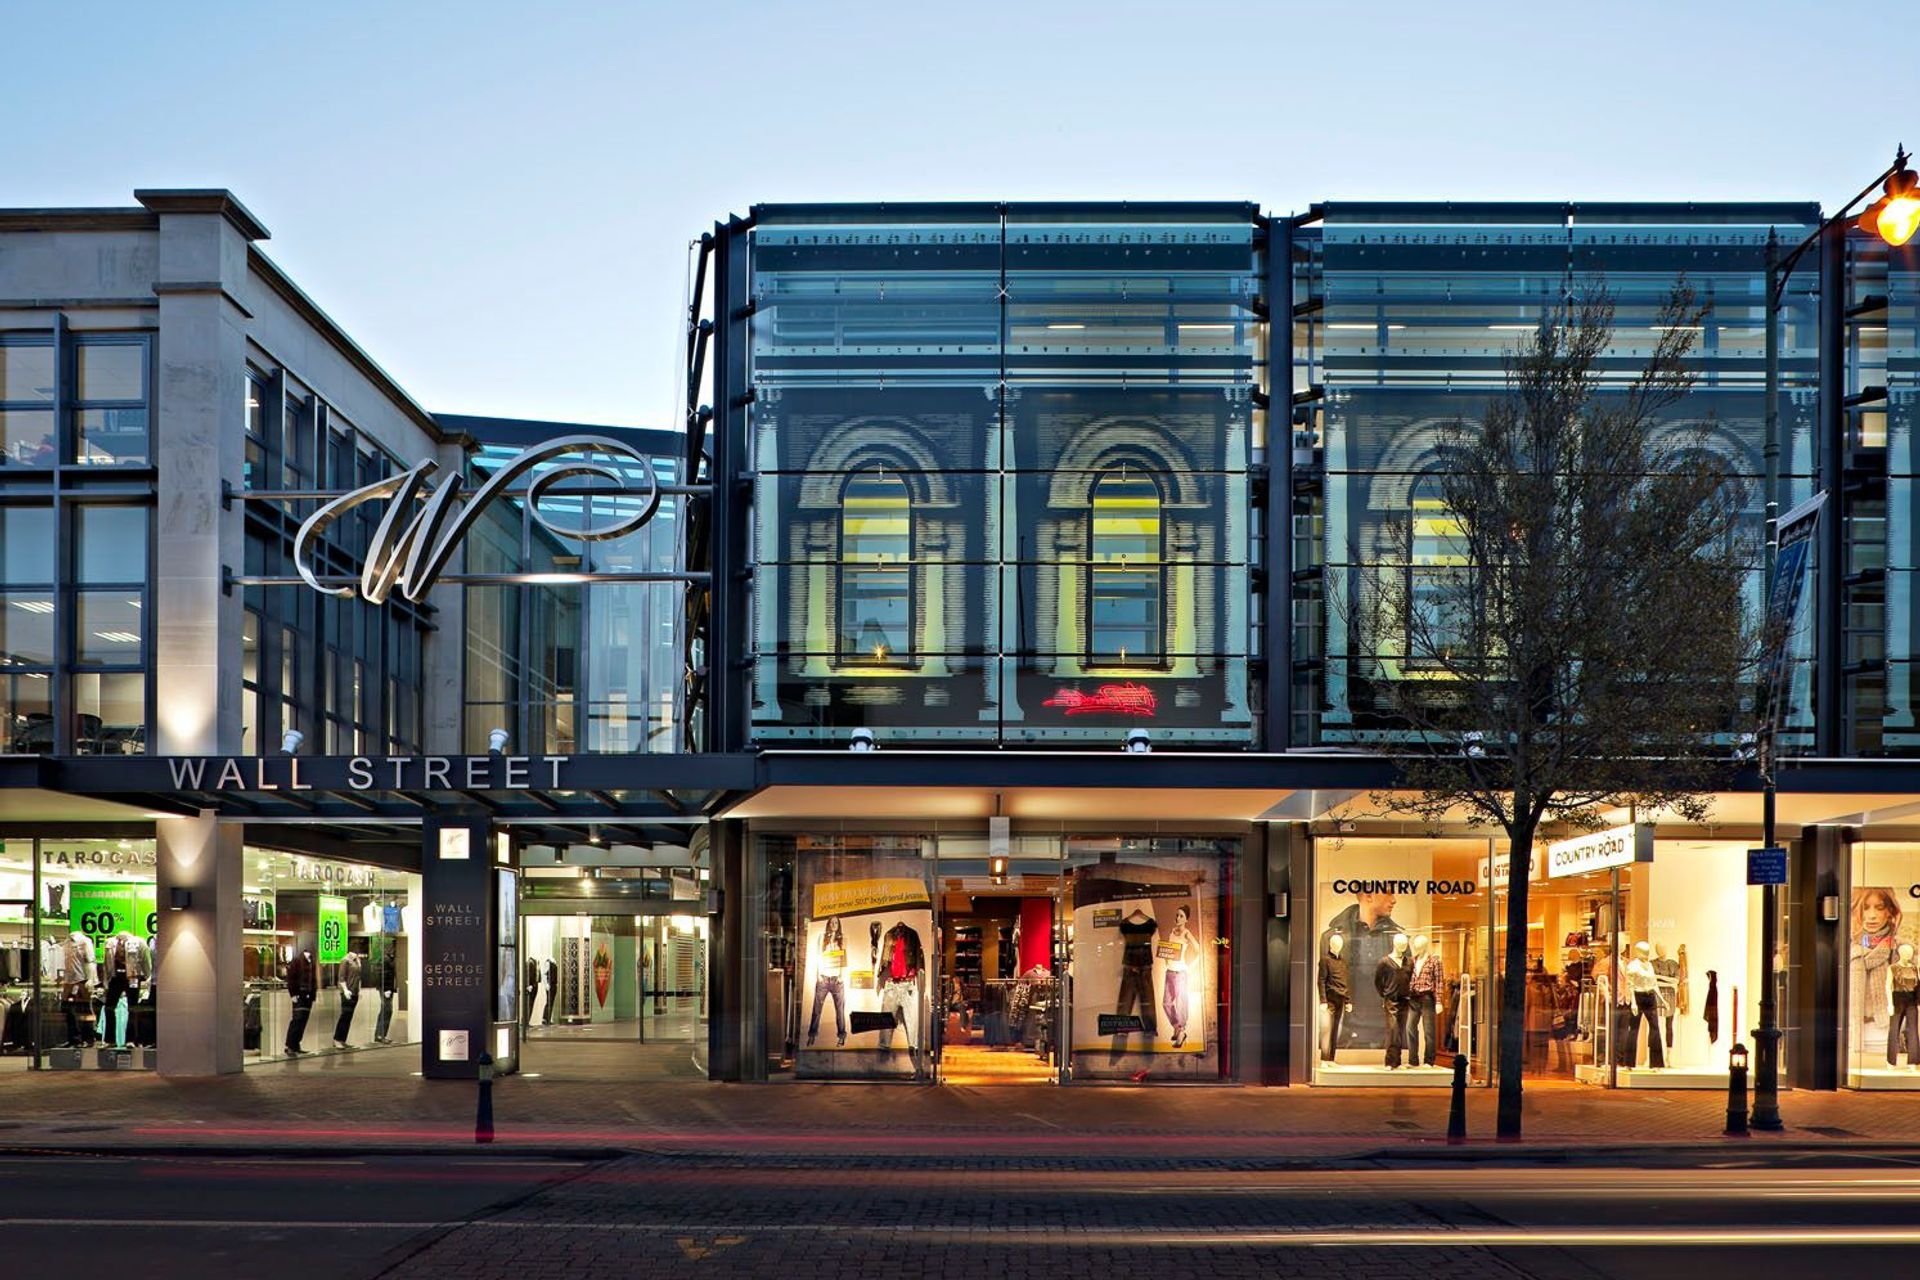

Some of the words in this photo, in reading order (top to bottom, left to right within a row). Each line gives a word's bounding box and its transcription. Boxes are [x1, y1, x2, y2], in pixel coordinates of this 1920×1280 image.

[168, 757, 313, 790] WALL
[347, 757, 569, 790] STREET
[1555, 845, 1596, 867] COUNTRY
[1598, 838, 1625, 857] ROAD
[1333, 880, 1420, 895] COUNTRY
[1426, 880, 1476, 895] ROAD
[435, 904, 472, 913] WALL
[426, 916, 480, 925] STREET
[443, 952, 465, 961] 211
[425, 964, 483, 974] GEORGE
[427, 976, 480, 985] STREET
